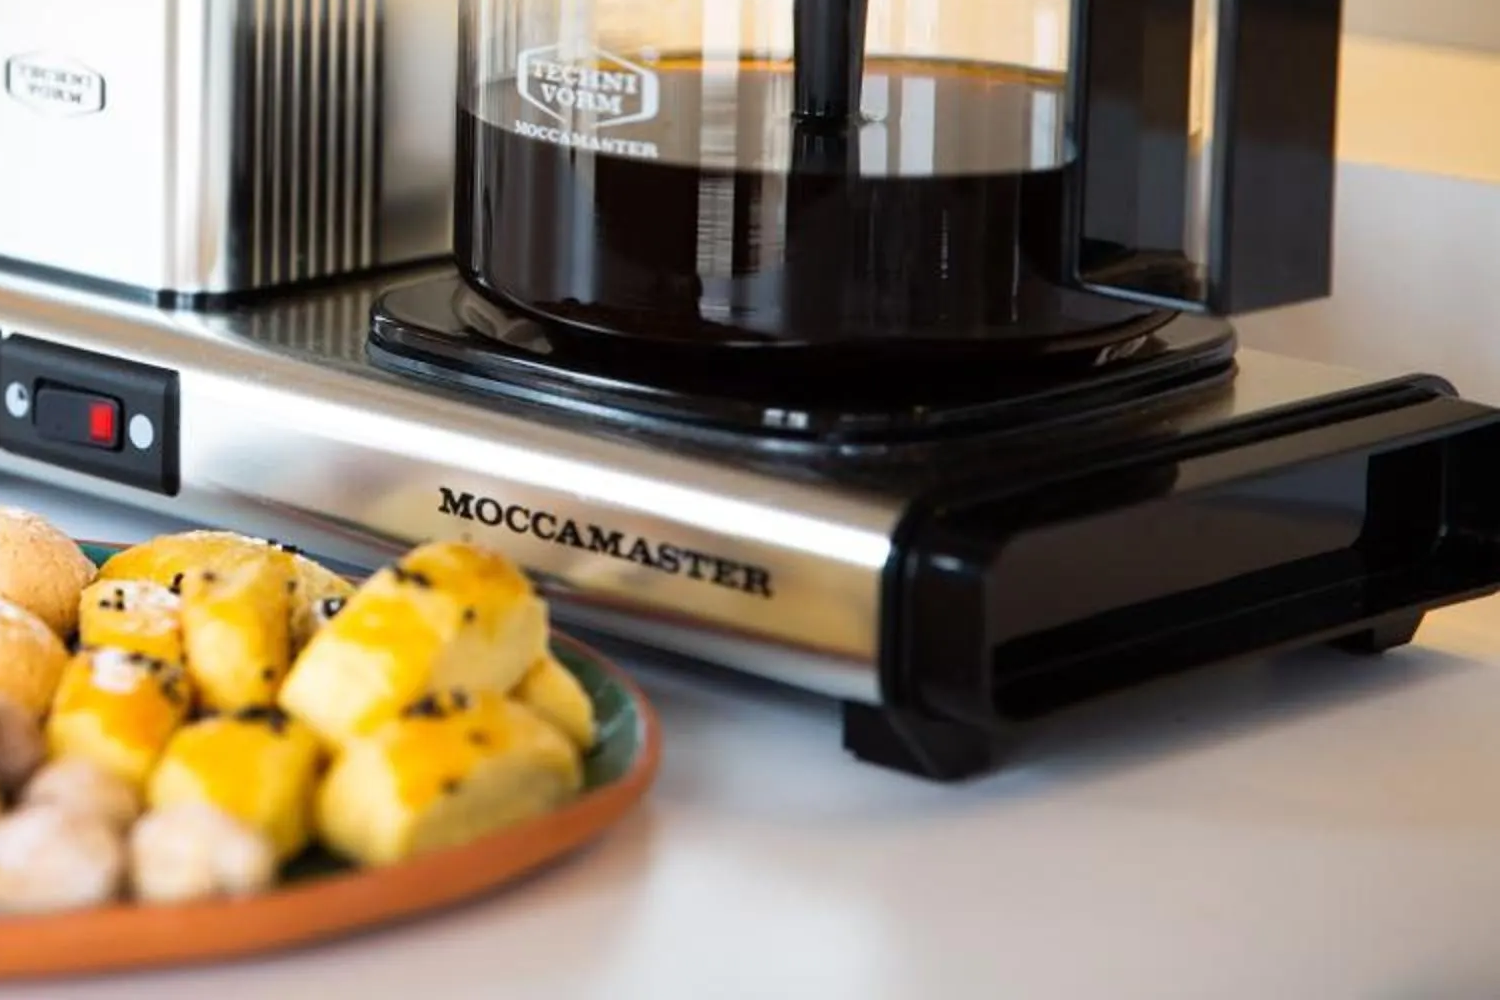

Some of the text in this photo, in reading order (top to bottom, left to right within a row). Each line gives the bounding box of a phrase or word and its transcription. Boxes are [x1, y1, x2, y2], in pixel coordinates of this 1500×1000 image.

[531, 59, 638, 94] TECHNI
[541, 83, 623, 115] VORM
[514, 119, 659, 159] MOCCAMASTER
[438, 486, 775, 599] MOCCAMASTER
